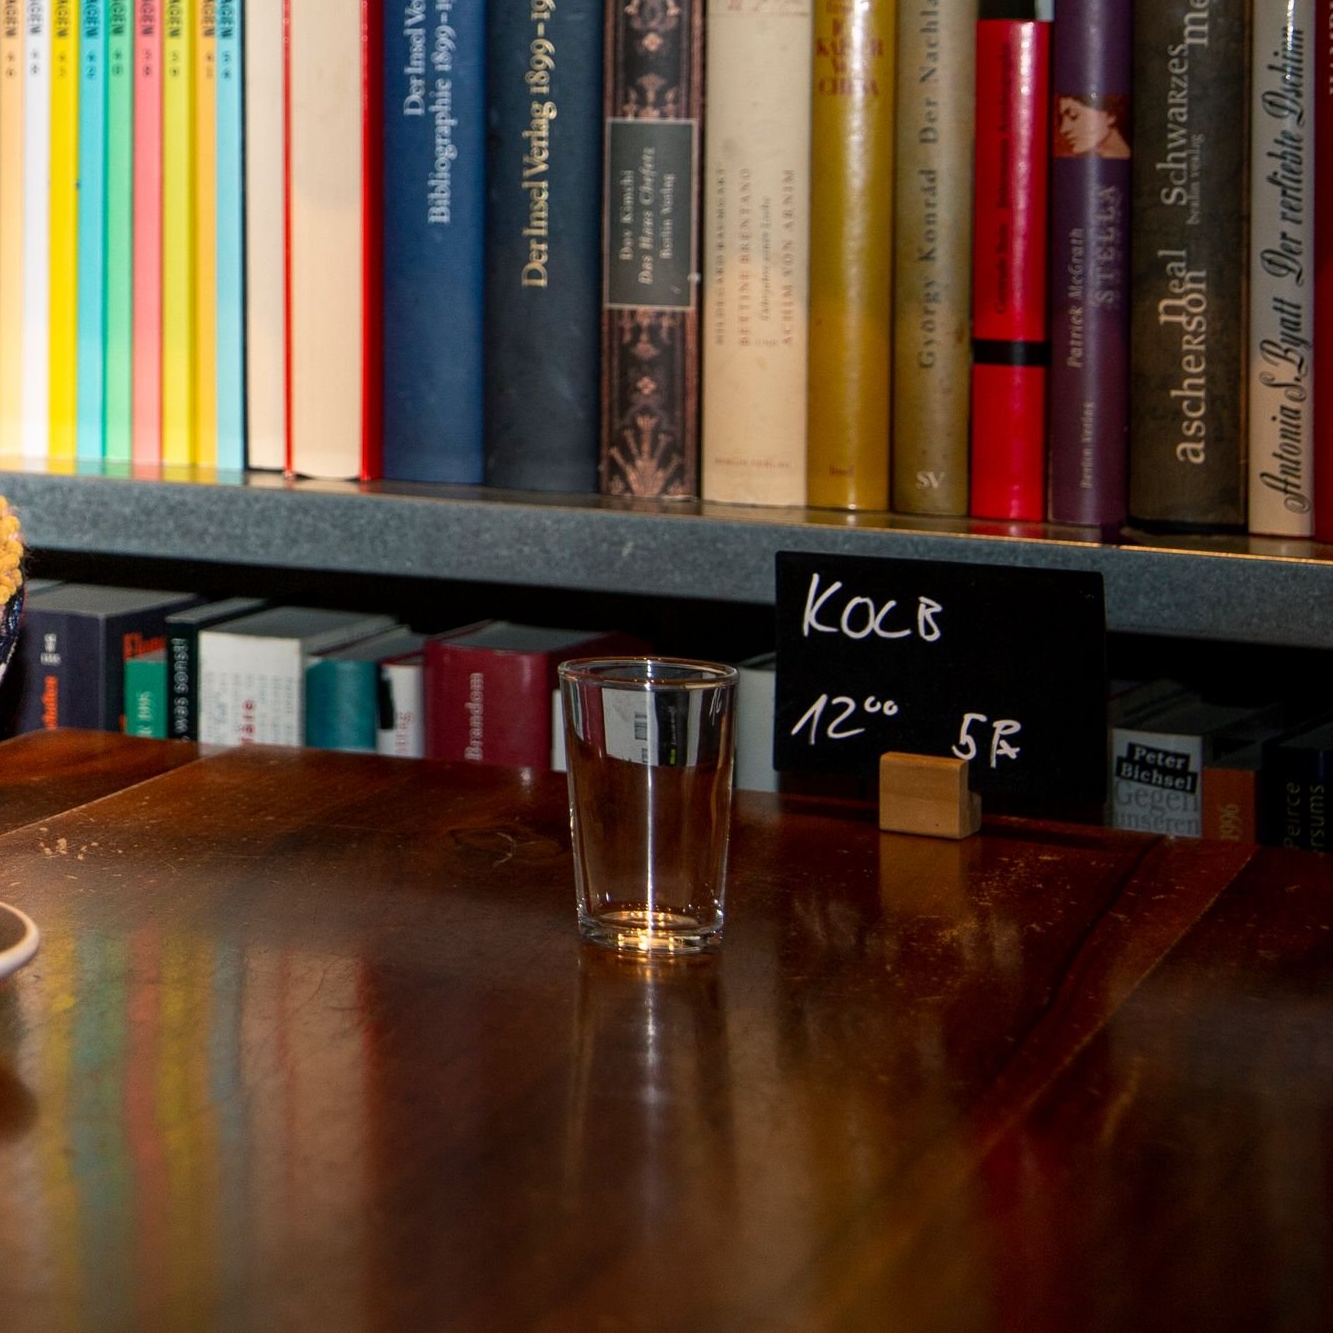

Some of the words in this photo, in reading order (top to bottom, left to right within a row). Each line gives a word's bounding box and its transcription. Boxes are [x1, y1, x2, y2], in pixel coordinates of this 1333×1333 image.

[403, 28, 426, 74] Insel
[1268, 25, 1309, 124] Dschinn
[403, 75, 426, 116] Der
[918, 100, 940, 146] Der
[427, 77, 458, 224] Bibliographie
[521, 101, 557, 177] Verlag
[522, 180, 550, 236] Insel
[619, 170, 634, 224] Kimchi
[780, 169, 795, 231] ARNIM
[1269, 129, 1305, 226] verliebte
[639, 210, 654, 250] Haus
[659, 219, 673, 259] Berlin
[739, 169, 752, 264] BRENTANO
[917, 167, 940, 263] Konrád
[1093, 185, 1118, 305] STELLA
[521, 237, 549, 288] Der
[638, 255, 654, 285] Das
[780, 240, 794, 278] VON
[1068, 227, 1085, 300] McGrath
[1258, 231, 1306, 288] Der
[737, 271, 751, 346] BETTINE
[781, 284, 794, 346] ACHIM
[916, 275, 940, 370] György
[1067, 306, 1085, 369] Patrick
[1259, 405, 1312, 515] Antonia
[464, 672, 484, 760] Brandom
[1120, 762, 1193, 790] Bichsel
[1133, 746, 1186, 769] Peter
[1116, 780, 1198, 816] Gegen
